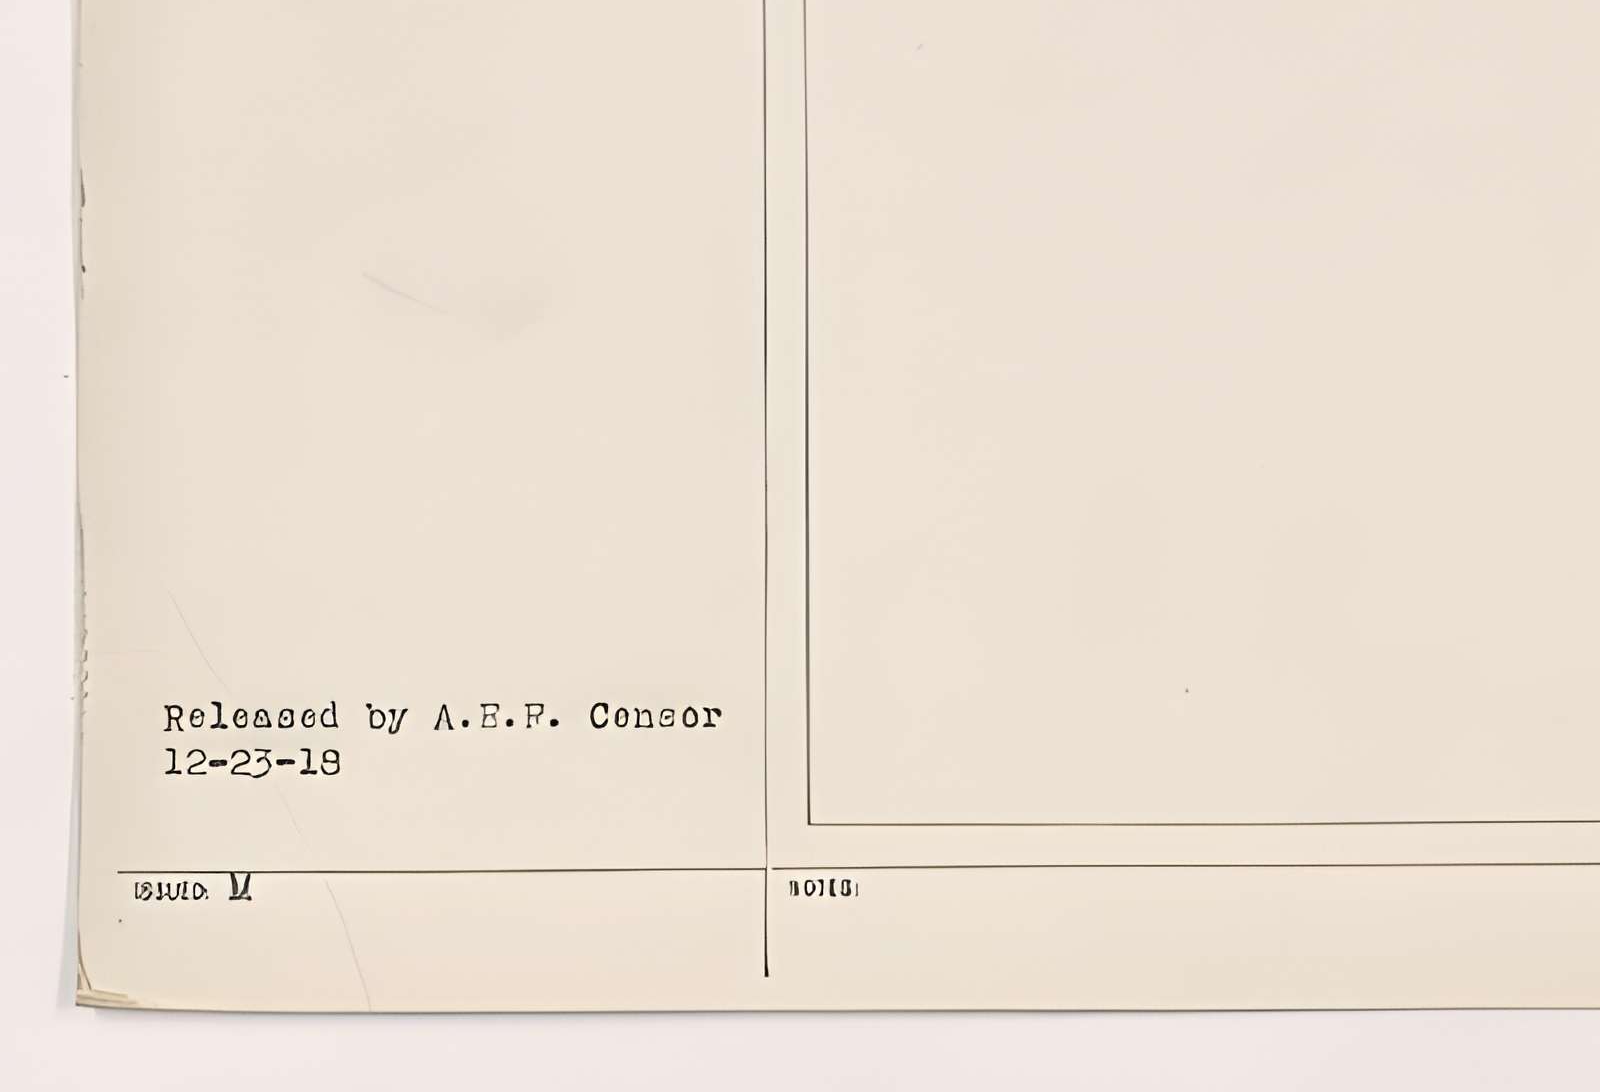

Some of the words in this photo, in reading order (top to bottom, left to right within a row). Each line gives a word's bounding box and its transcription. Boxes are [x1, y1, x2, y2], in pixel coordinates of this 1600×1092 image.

[163, 700, 340, 732] Released
[365, 702, 409, 735] by
[433, 702, 561, 731] A.E.F.
[589, 701, 723, 730] Censor
[164, 747, 341, 778] 12-23-18
